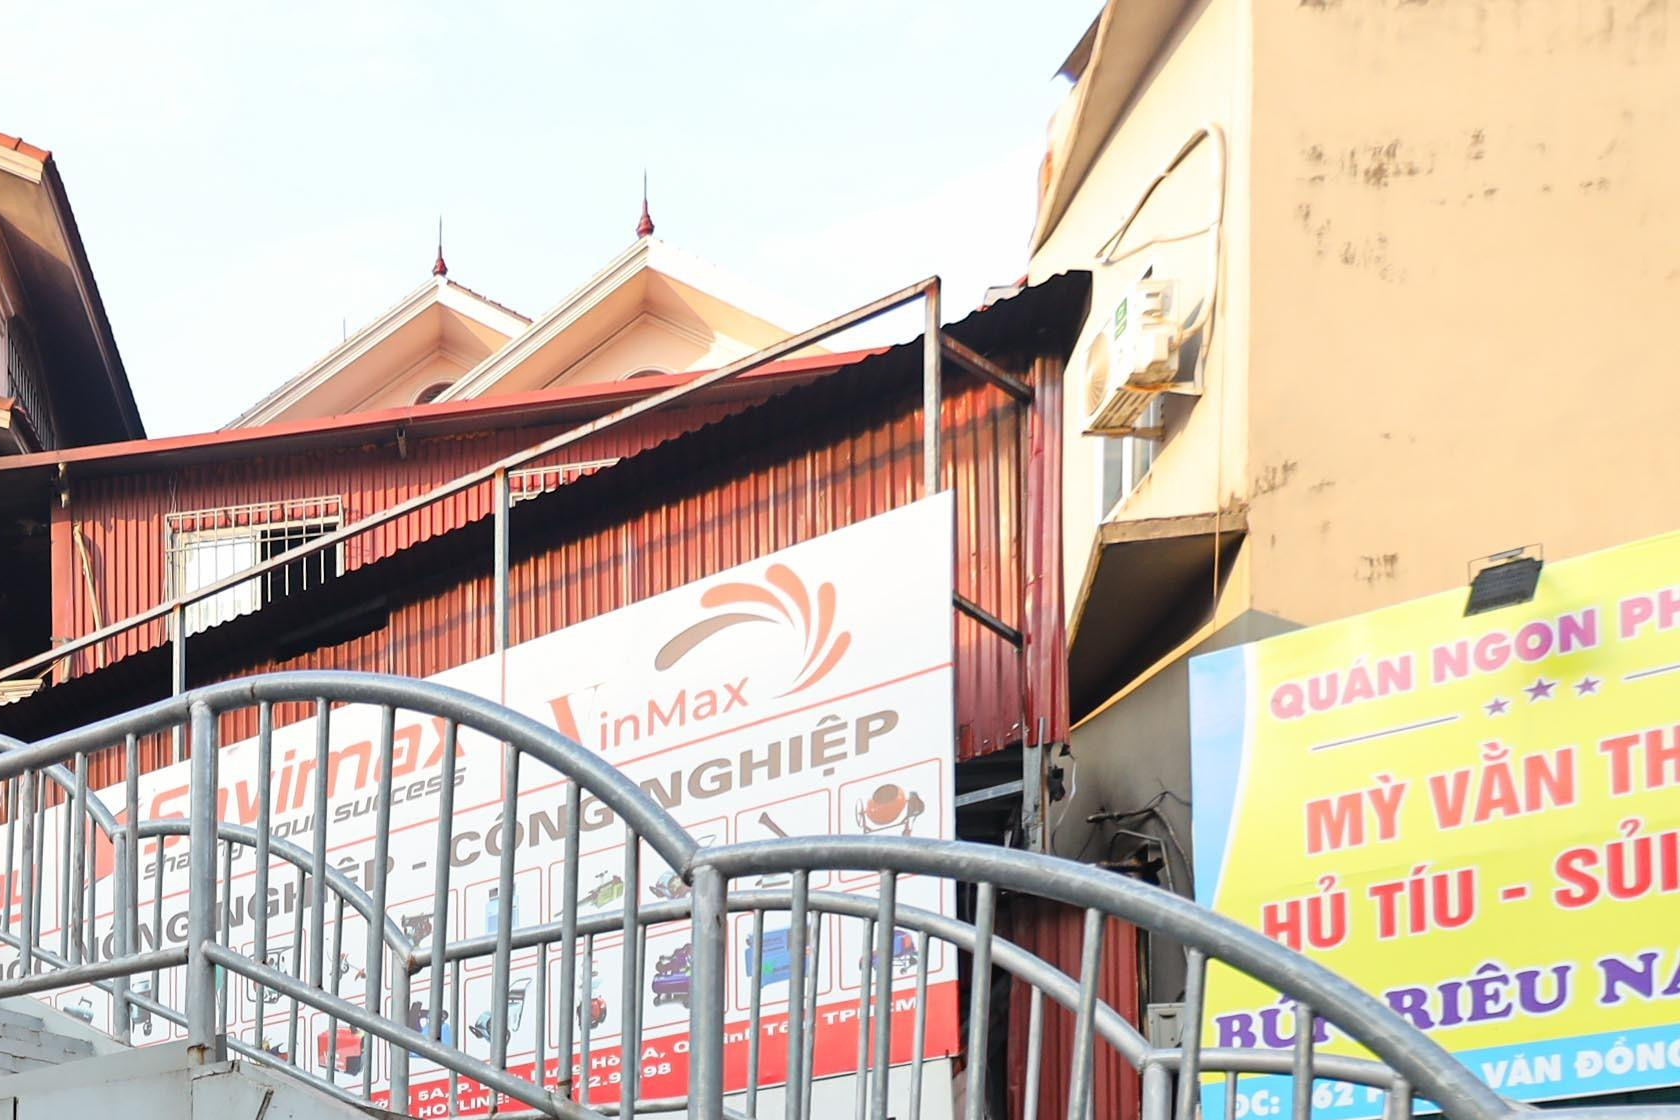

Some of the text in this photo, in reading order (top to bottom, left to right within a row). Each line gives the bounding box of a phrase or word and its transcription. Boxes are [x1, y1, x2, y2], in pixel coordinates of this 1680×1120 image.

[1270, 655, 1413, 719] QUÁN
[1432, 608, 1597, 683] NGON
[143, 714, 466, 856] Svimax
[642, 709, 900, 810] NGHIỆP
[1306, 774, 1407, 855] MỲ
[1263, 875, 1347, 952] HỦ
[1369, 864, 1475, 939] TÍU
[1554, 818, 1678, 909] SỦI
[1385, 962, 1572, 1032] RIÊU
[1481, 1050, 1562, 1090] VĂN
